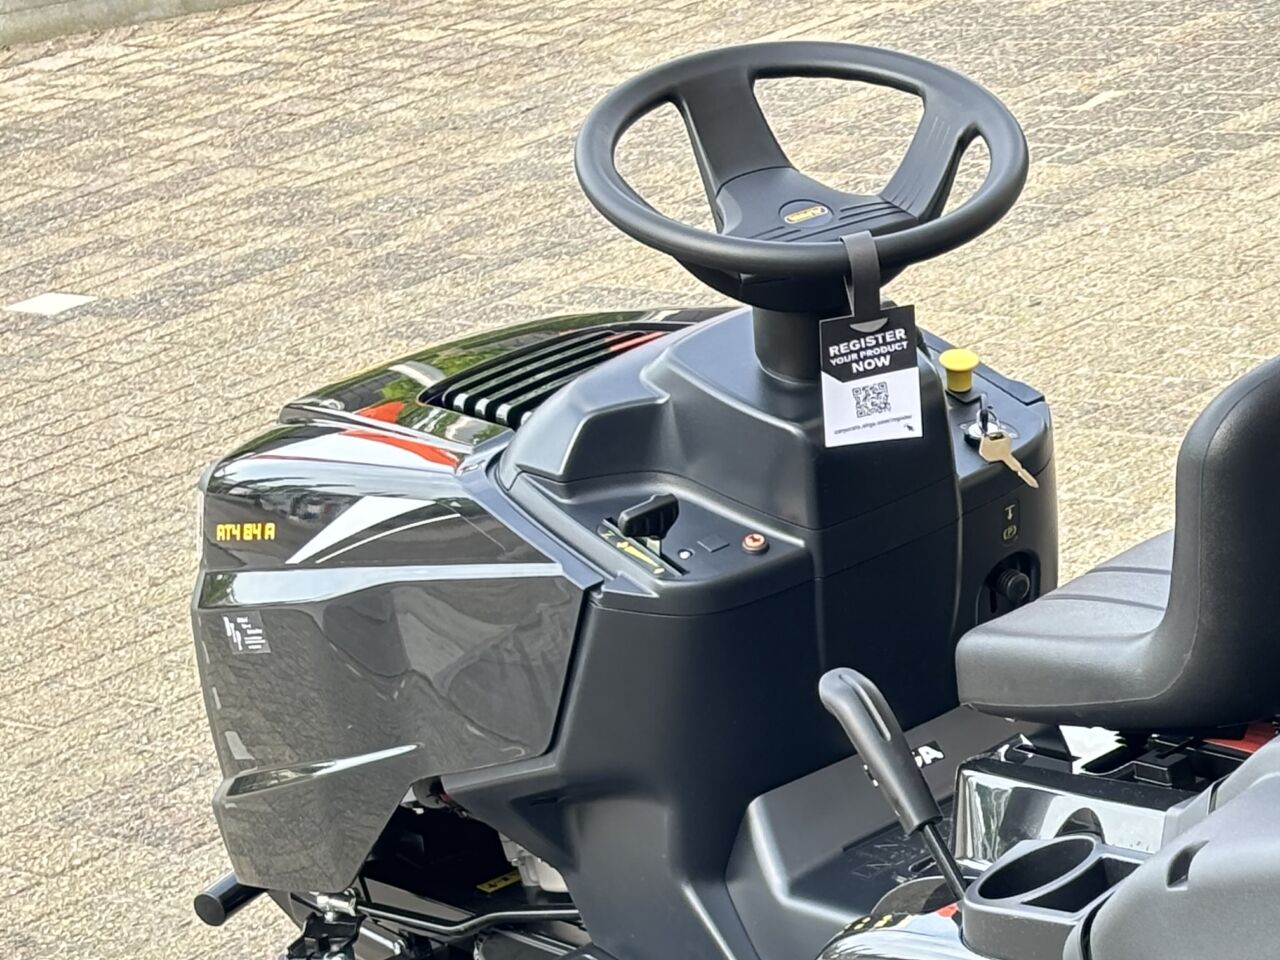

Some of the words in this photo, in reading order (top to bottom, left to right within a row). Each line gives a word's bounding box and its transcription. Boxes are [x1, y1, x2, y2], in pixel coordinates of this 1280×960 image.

[829, 328, 907, 357] REGISTER
[831, 352, 859, 367] YOUR
[860, 341, 909, 360] PRODUCT
[852, 355, 891, 373] NOW
[216, 524, 241, 541] AT4
[264, 522, 276, 540] A
